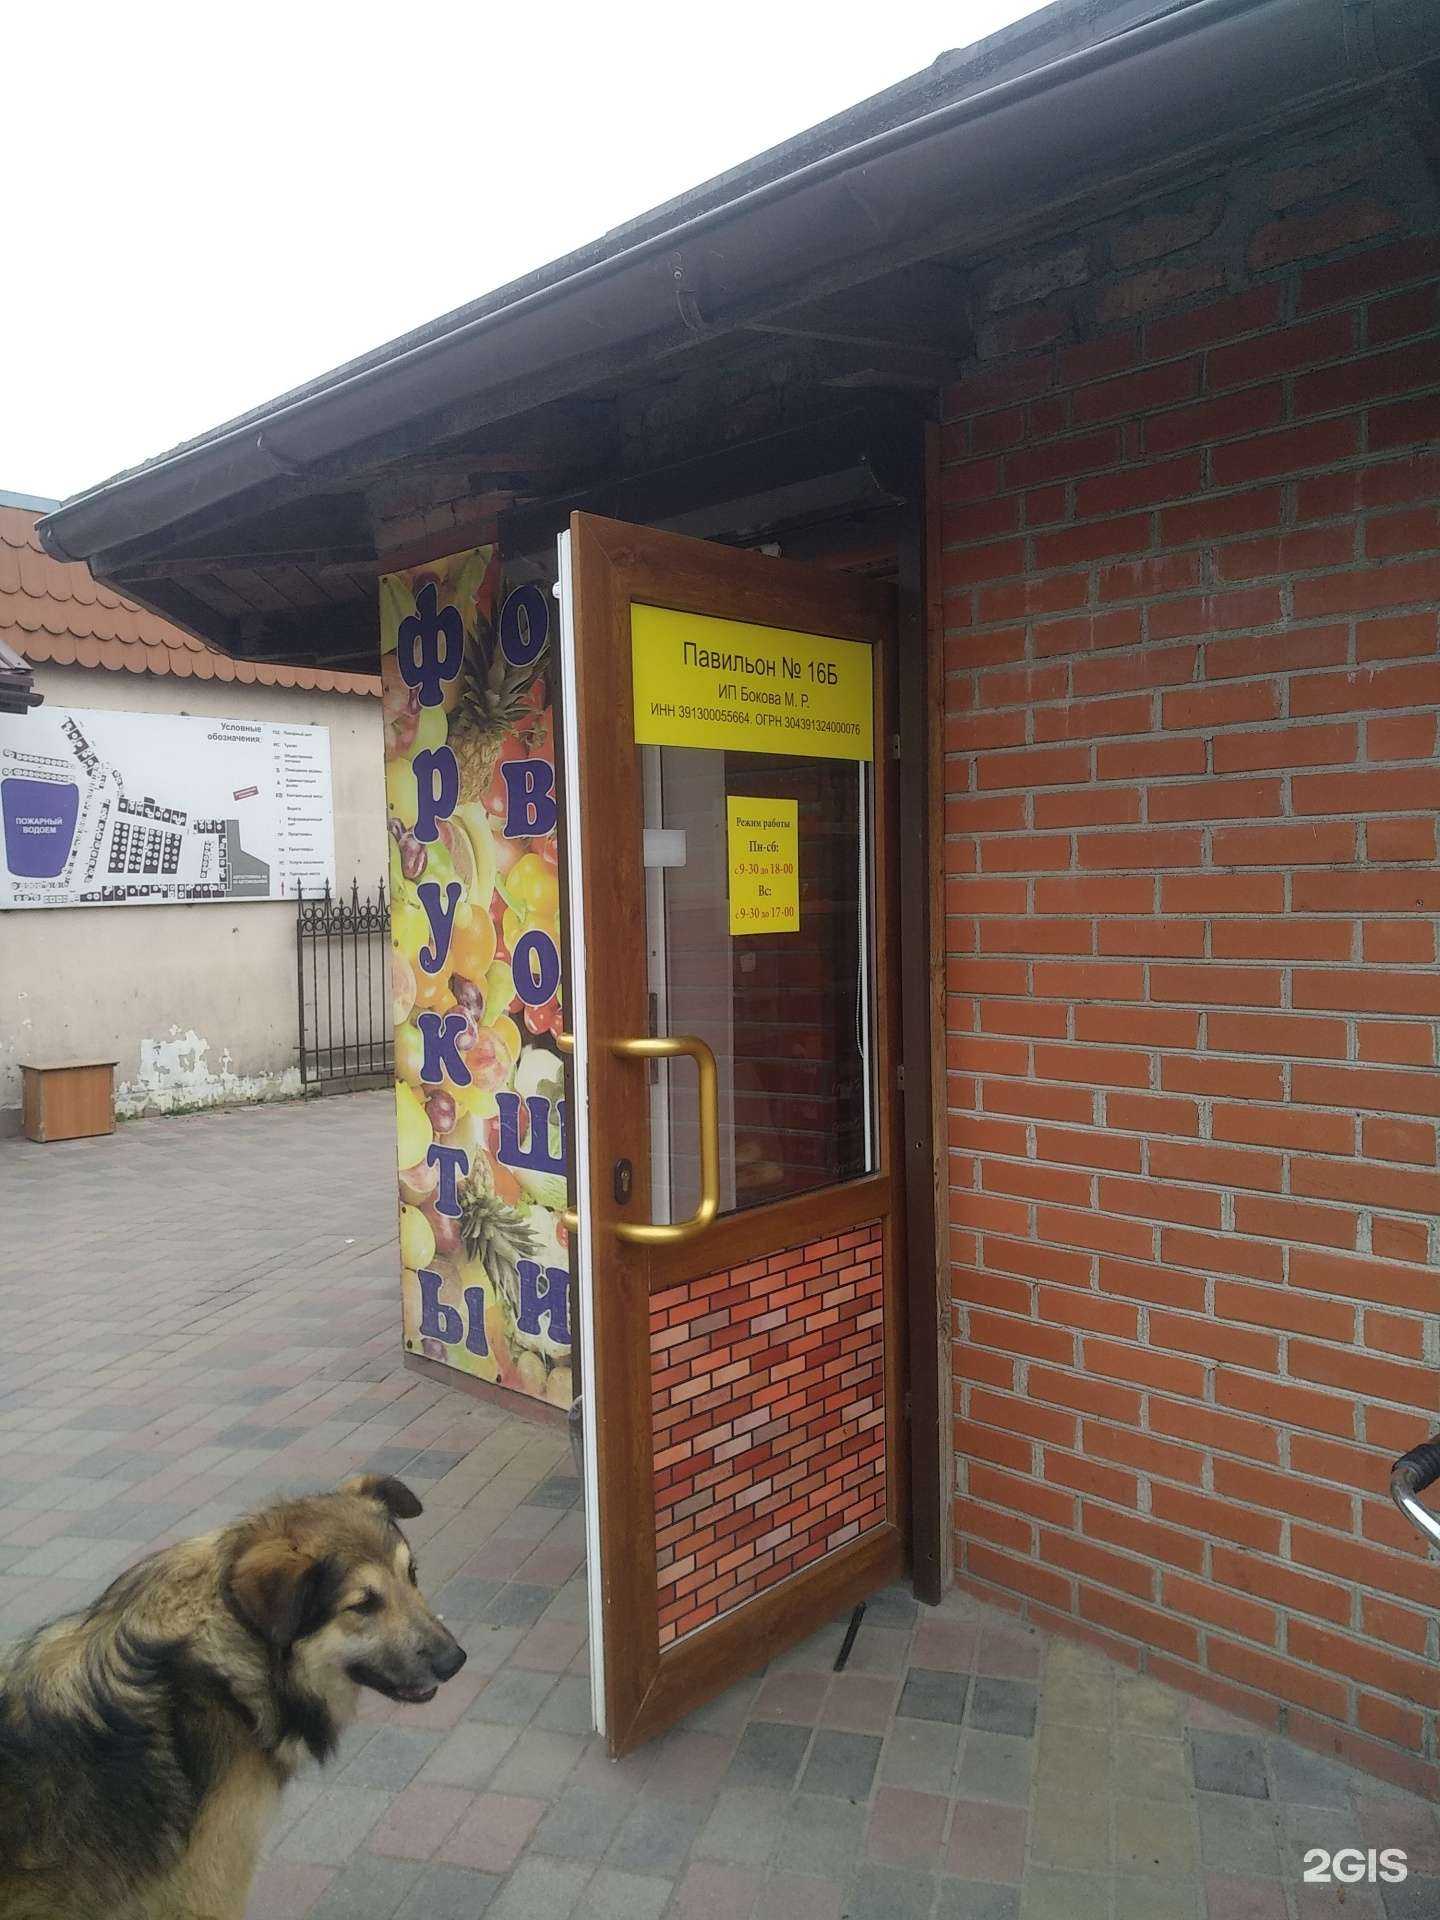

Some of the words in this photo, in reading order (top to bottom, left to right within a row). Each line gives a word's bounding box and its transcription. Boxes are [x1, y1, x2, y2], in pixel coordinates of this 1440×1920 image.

[683, 641, 776, 677] Павильон
[782, 656, 801, 679] №
[808, 663, 838, 685] 16Б
[718, 683, 737, 700] ИП
[740, 687, 781, 705] Бокова
[651, 702, 675, 716] ИНН
[755, 713, 782, 727] ОГРН
[221, 722, 261, 732] Условные
[15, 817, 63, 826] ПОЖАРНЫЙ
[736, 817, 761, 827] Режим
[763, 819, 790, 830] работы
